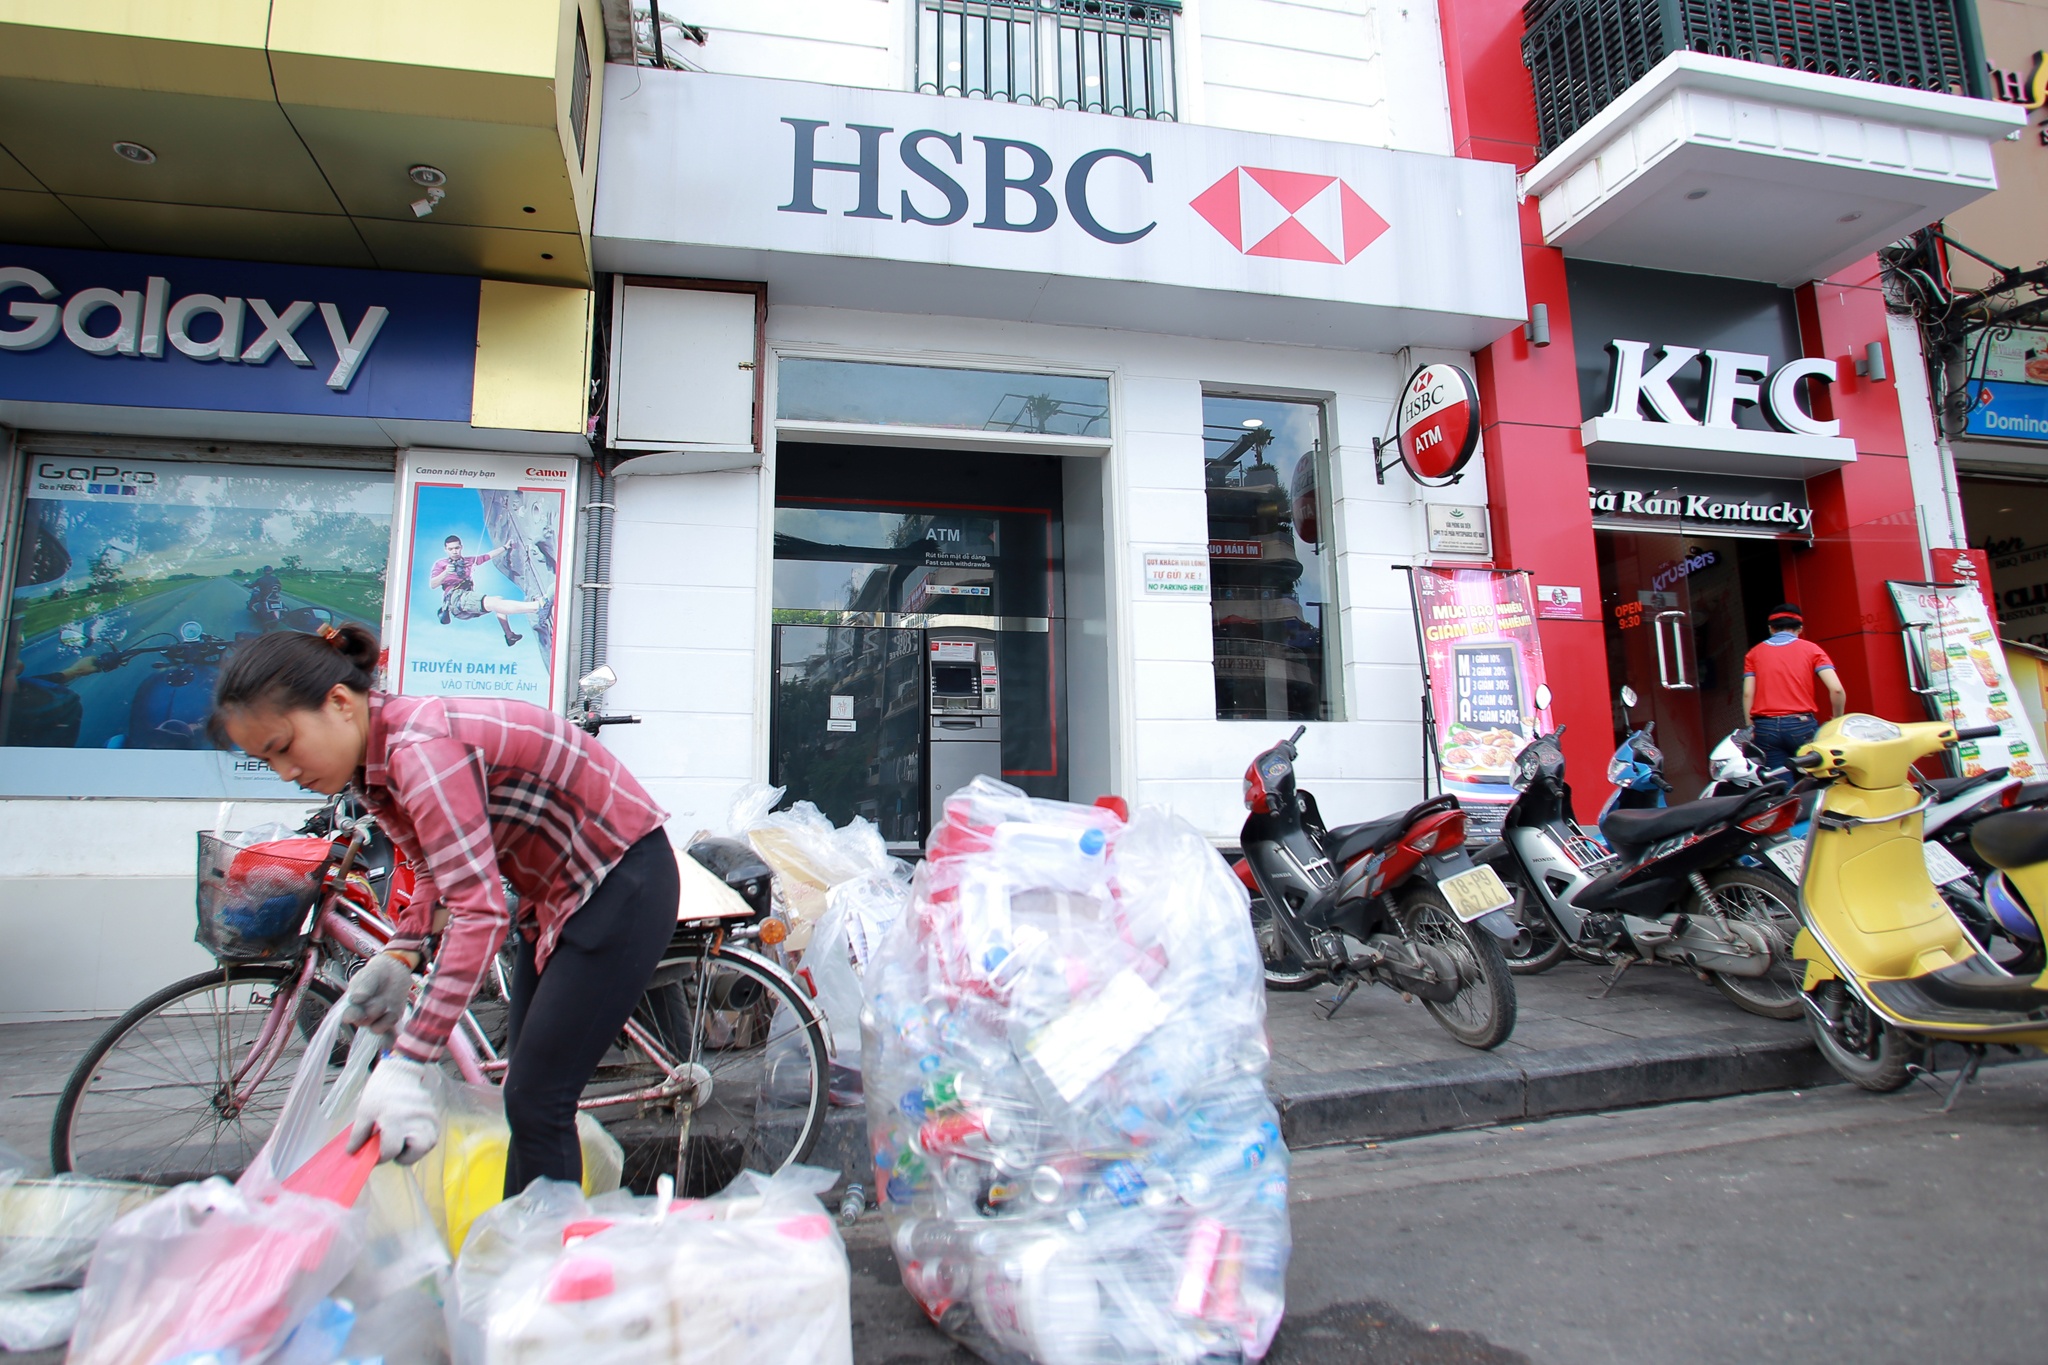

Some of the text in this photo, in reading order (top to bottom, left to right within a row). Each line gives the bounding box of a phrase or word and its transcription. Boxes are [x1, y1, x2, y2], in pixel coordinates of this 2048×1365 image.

[777, 117, 1157, 244] HSBC
[0, 266, 390, 391] Galaxy
[1603, 339, 1840, 437] KFC
[1405, 385, 1444, 424] HSBC
[1415, 425, 1442, 455] ATM
[38, 463, 157, 484] GoPro
[415, 466, 496, 479] Canon nói thay bạn
[525, 467, 567, 477] Canon
[1622, 489, 1681, 516] Rán
[1685, 495, 1813, 530] Kentucky
[926, 528, 960, 541] ATM
[1160, 558, 1179, 566] KHÁCH
[1432, 605, 1467, 620] MUA
[1470, 605, 1494, 618] BAO
[1615, 601, 1643, 618] OPEN
[1619, 615, 1641, 629] 9:30
[1426, 620, 1468, 641] GIẢM
[1475, 652, 1489, 664] GIẢM
[1490, 654, 1500, 663] 10%
[466, 663, 495, 674] ĐAM
[501, 662, 518, 675] MÊ
[1476, 664, 1492, 676] GIẢM
[1493, 666, 1506, 676] 20%
[441, 679, 538, 691] VÀO TỪNG BỨC ẢNH
[1477, 677, 1494, 690] GIẢM
[1495, 680, 1509, 690] 30%
[1478, 692, 1496, 706] GIẢM
[1498, 695, 1513, 706] 40%
[1479, 707, 1498, 722] GIẢM
[1499, 709, 1519, 724] 50%
